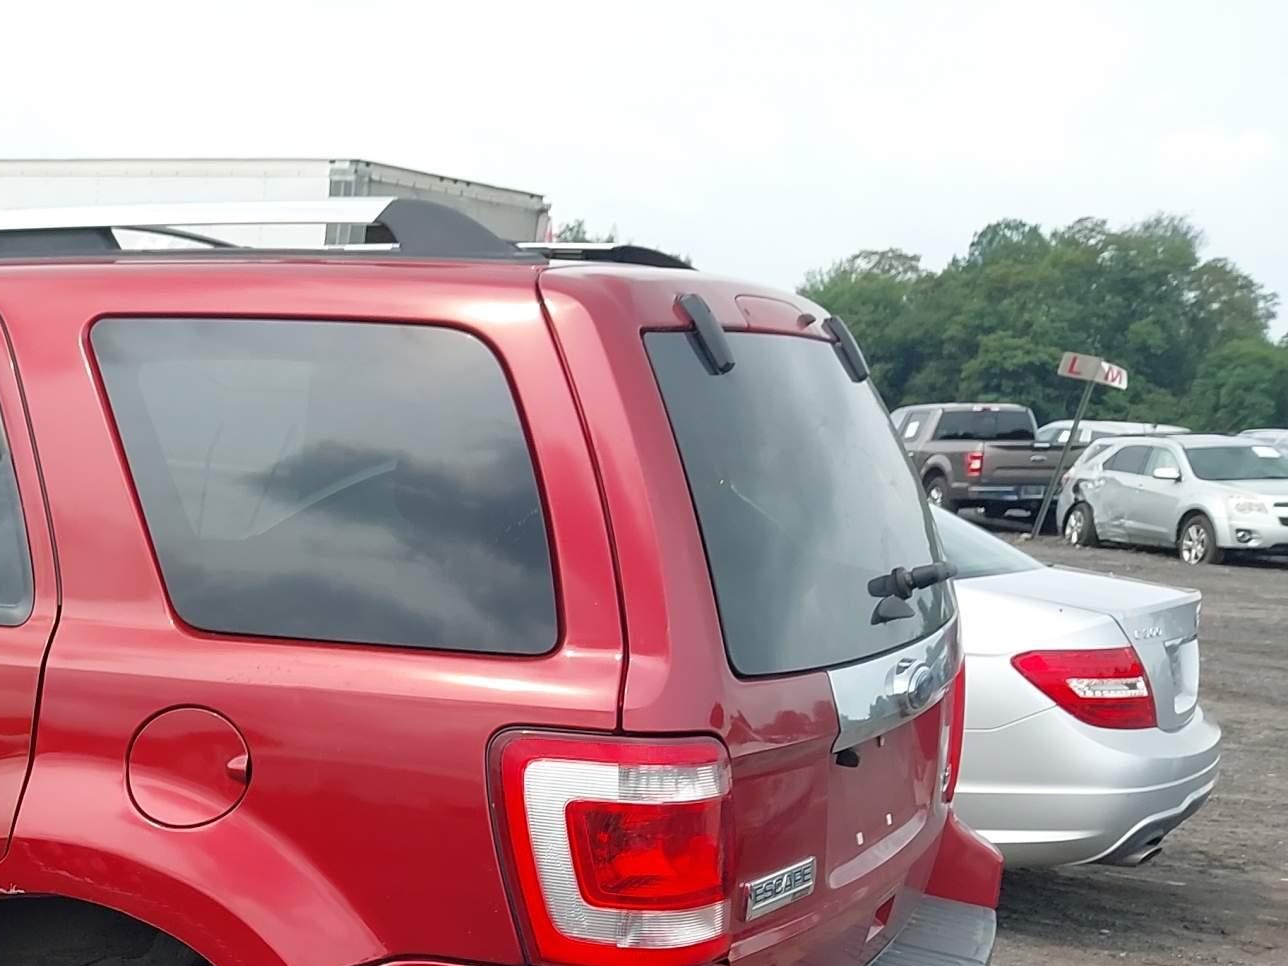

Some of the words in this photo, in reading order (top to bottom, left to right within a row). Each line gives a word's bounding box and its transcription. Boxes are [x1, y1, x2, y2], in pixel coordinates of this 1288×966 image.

[1067, 355, 1081, 375] L
[1104, 365, 1122, 385] M
[753, 866, 812, 903] ESCAPE
